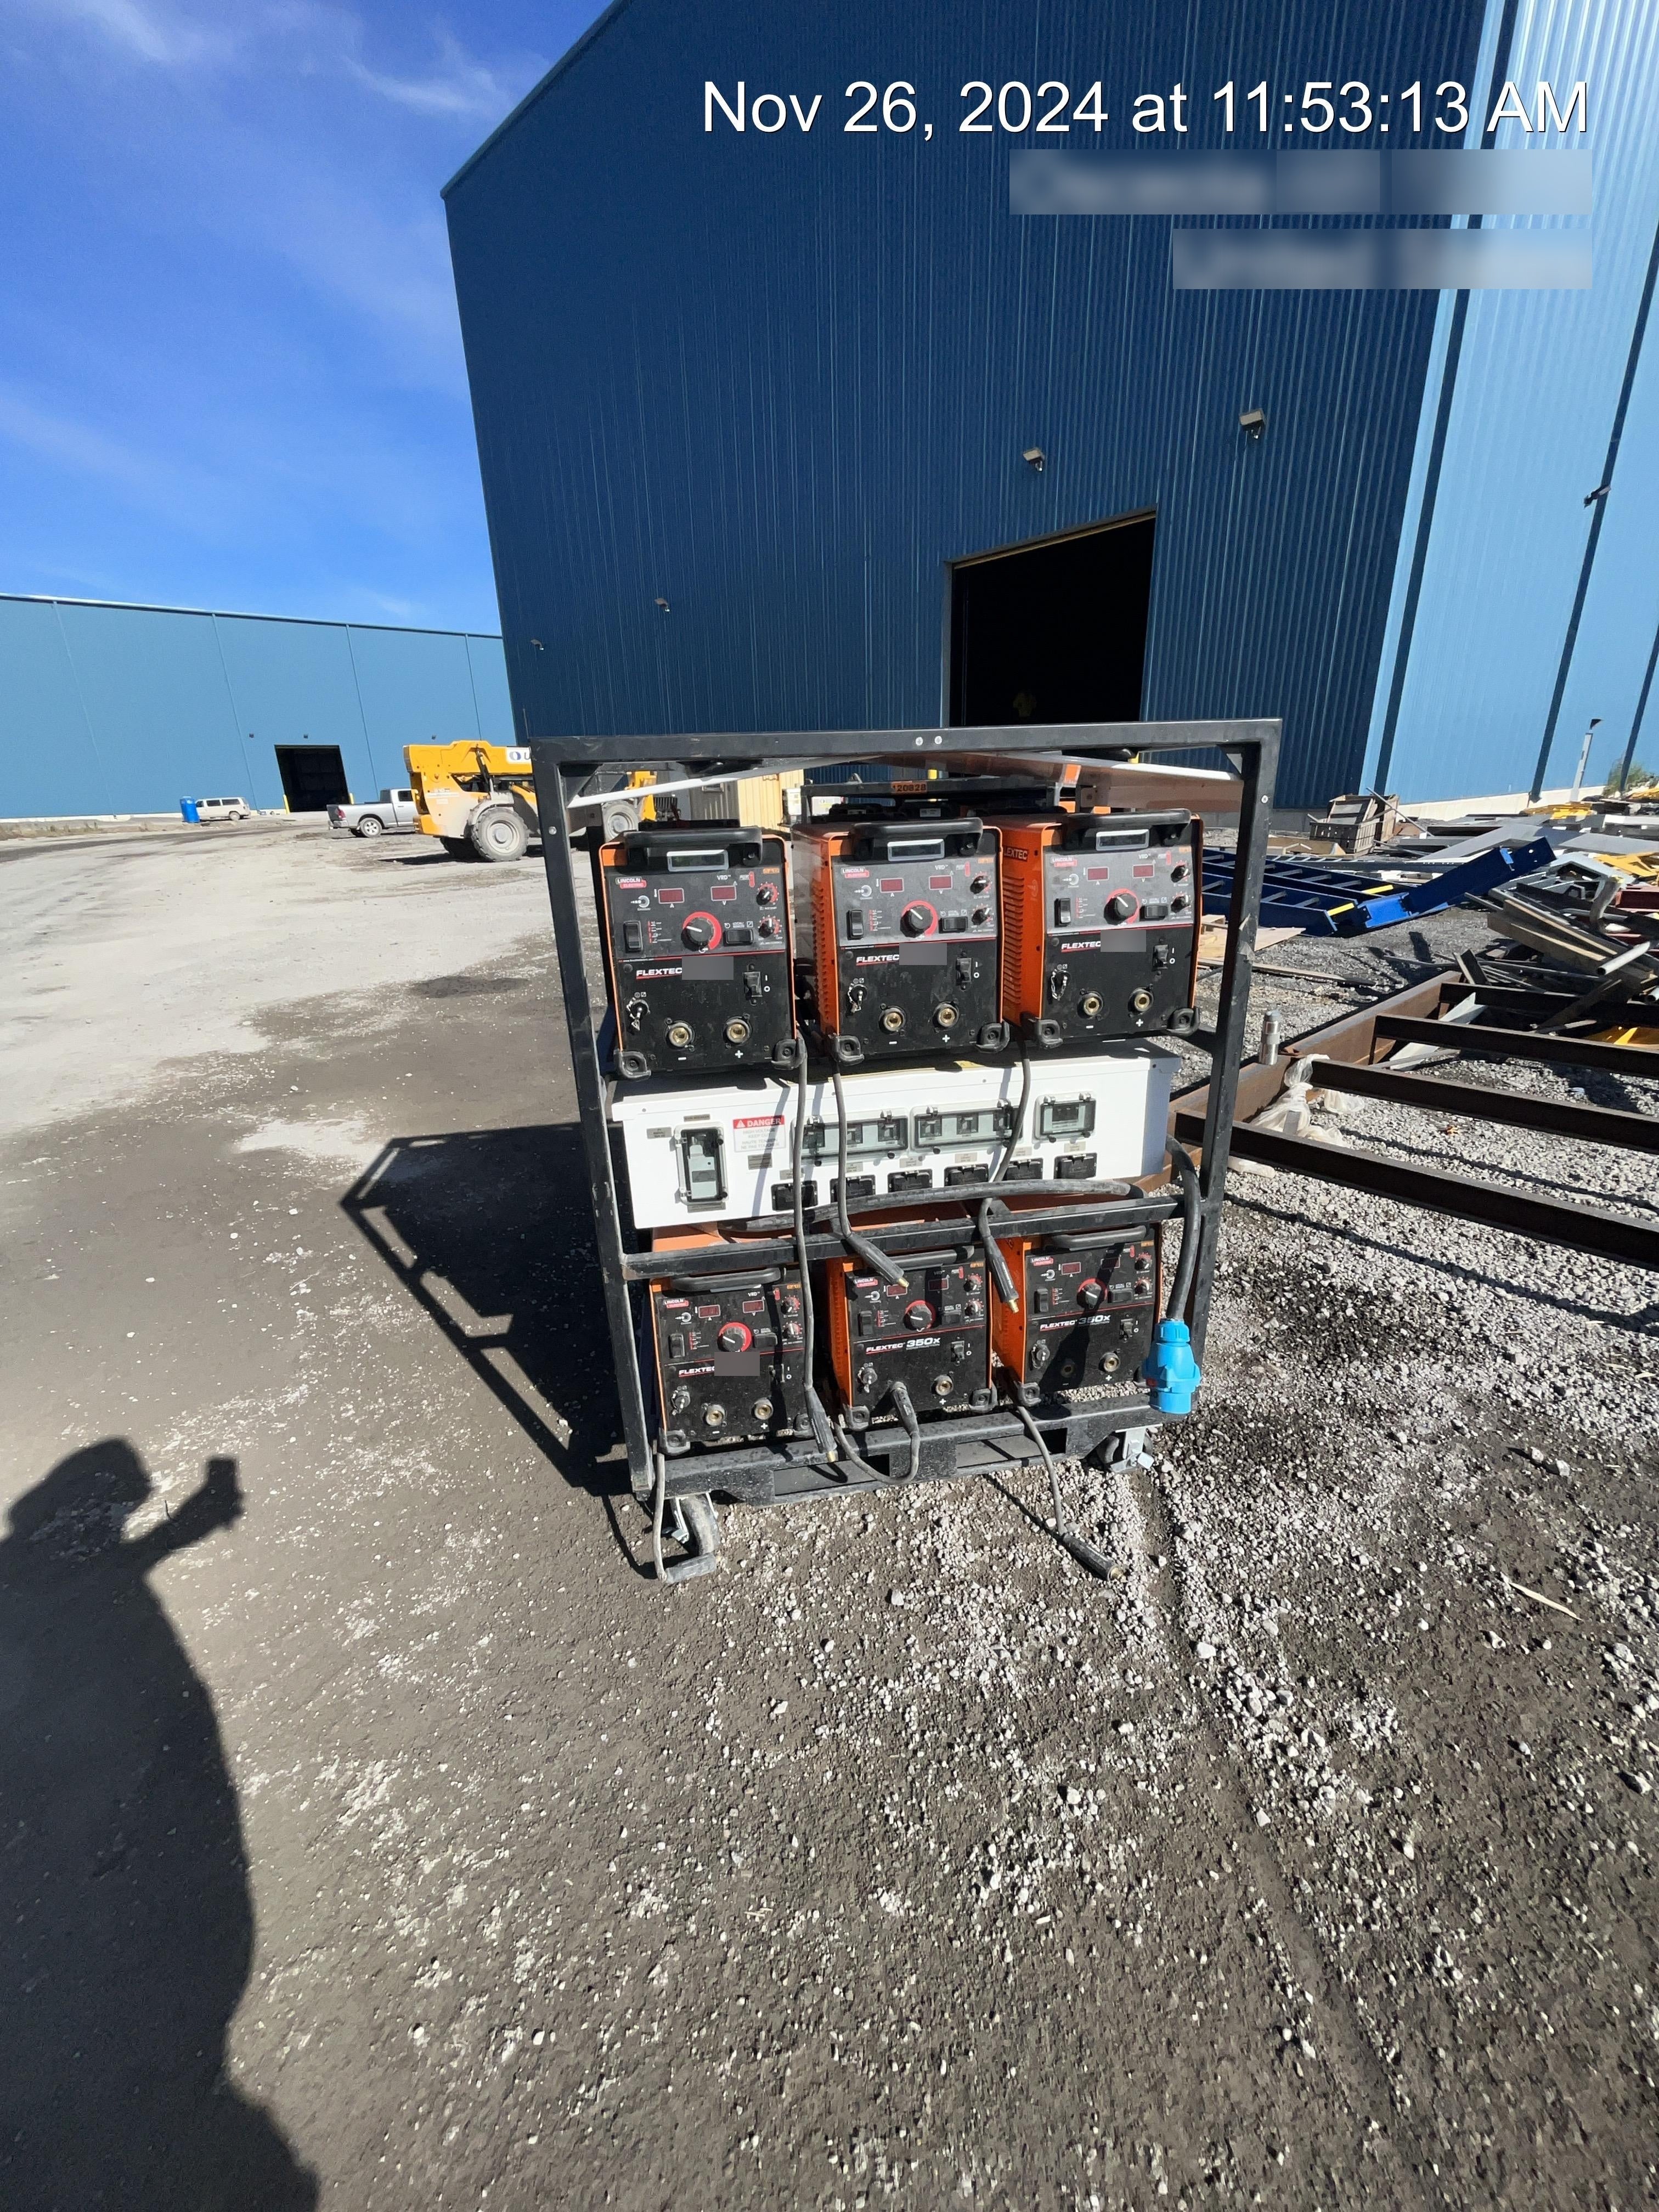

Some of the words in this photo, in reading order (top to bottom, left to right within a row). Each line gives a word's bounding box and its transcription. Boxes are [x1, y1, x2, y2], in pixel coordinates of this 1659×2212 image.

[1062, 941, 1101, 949] FLEXTEC
[856, 954, 899, 963] FLEXTEC
[636, 968, 682, 976] FLEXTEC
[1040, 1321, 1074, 1329] FLEXTEC
[866, 1344, 902, 1352] FLEXTEC
[906, 1338, 940, 1347] 350x
